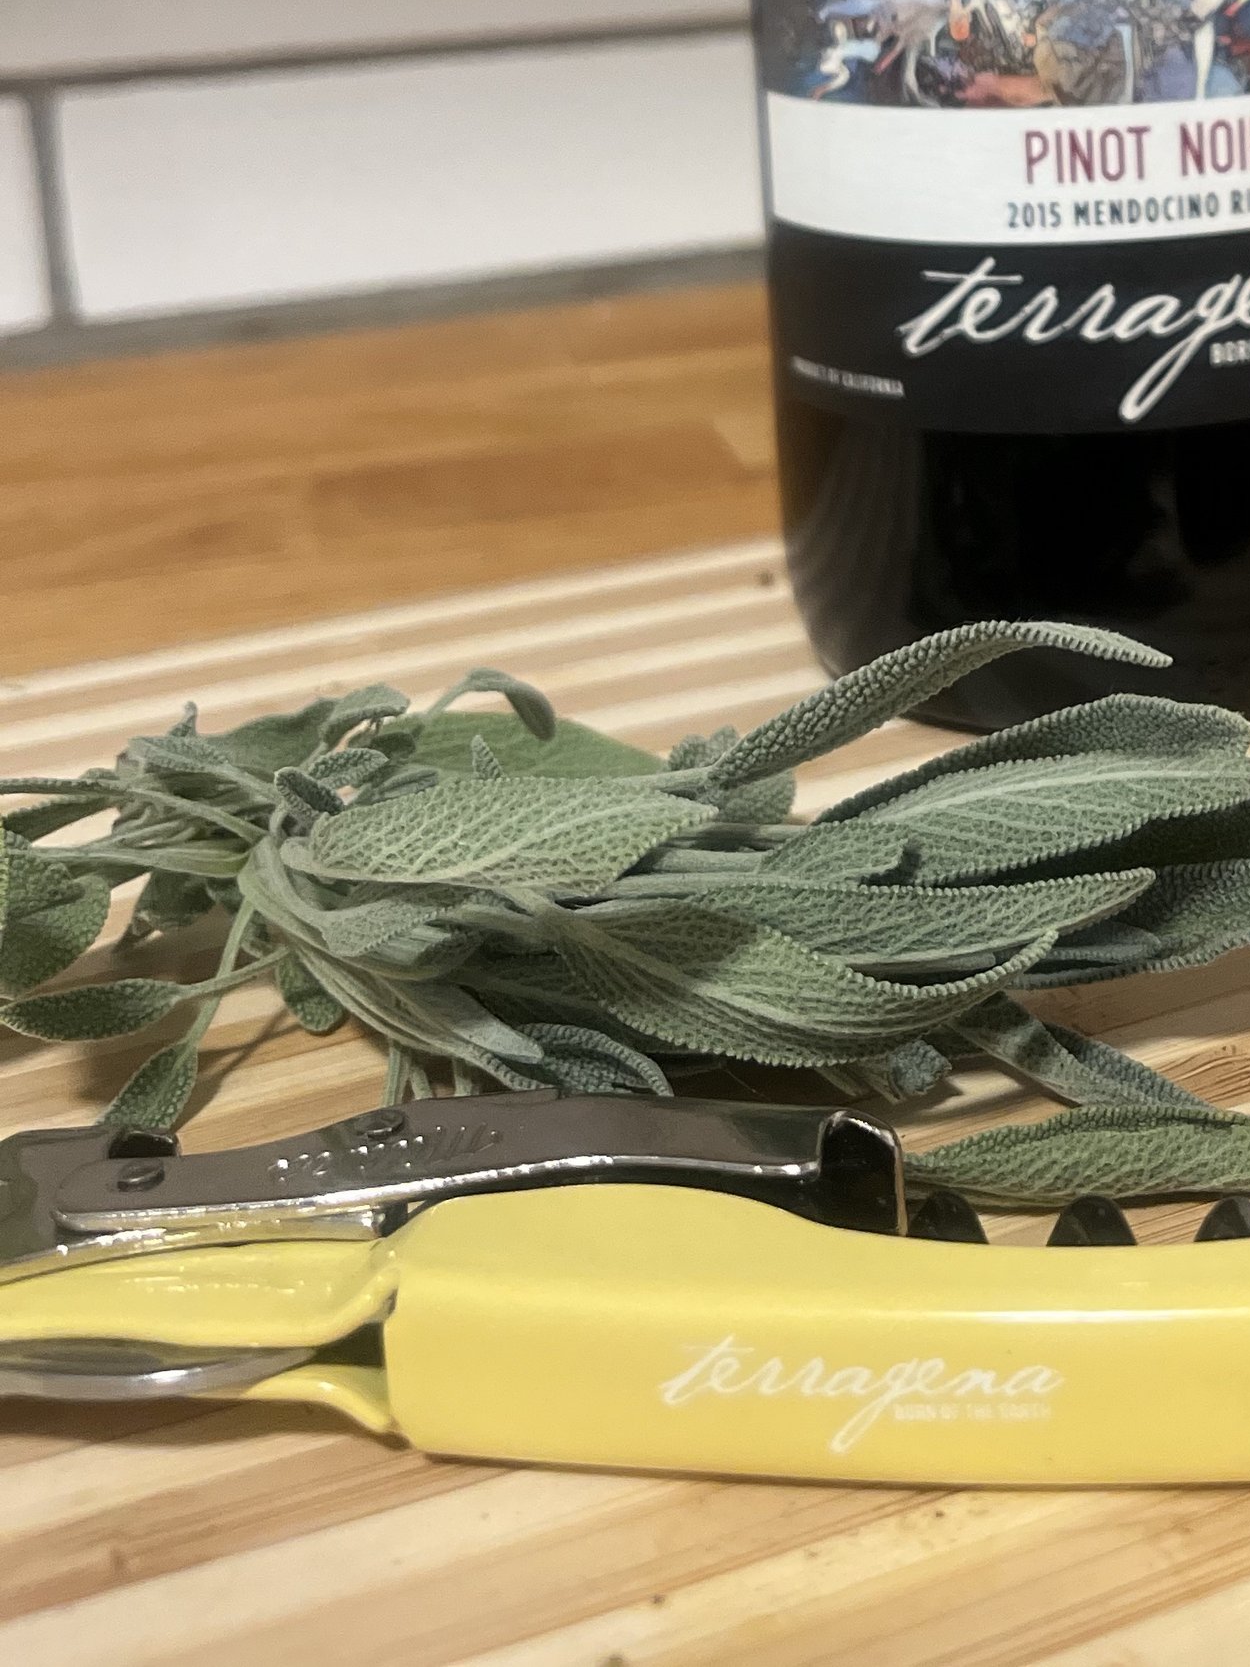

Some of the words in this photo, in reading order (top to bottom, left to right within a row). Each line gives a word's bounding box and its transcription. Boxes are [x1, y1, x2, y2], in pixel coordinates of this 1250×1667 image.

[1024, 126, 1152, 184] PINOT
[1007, 201, 1062, 229] 2015
[1073, 191, 1221, 227] MENDOCINO
[657, 1333, 1066, 1455] terragena
